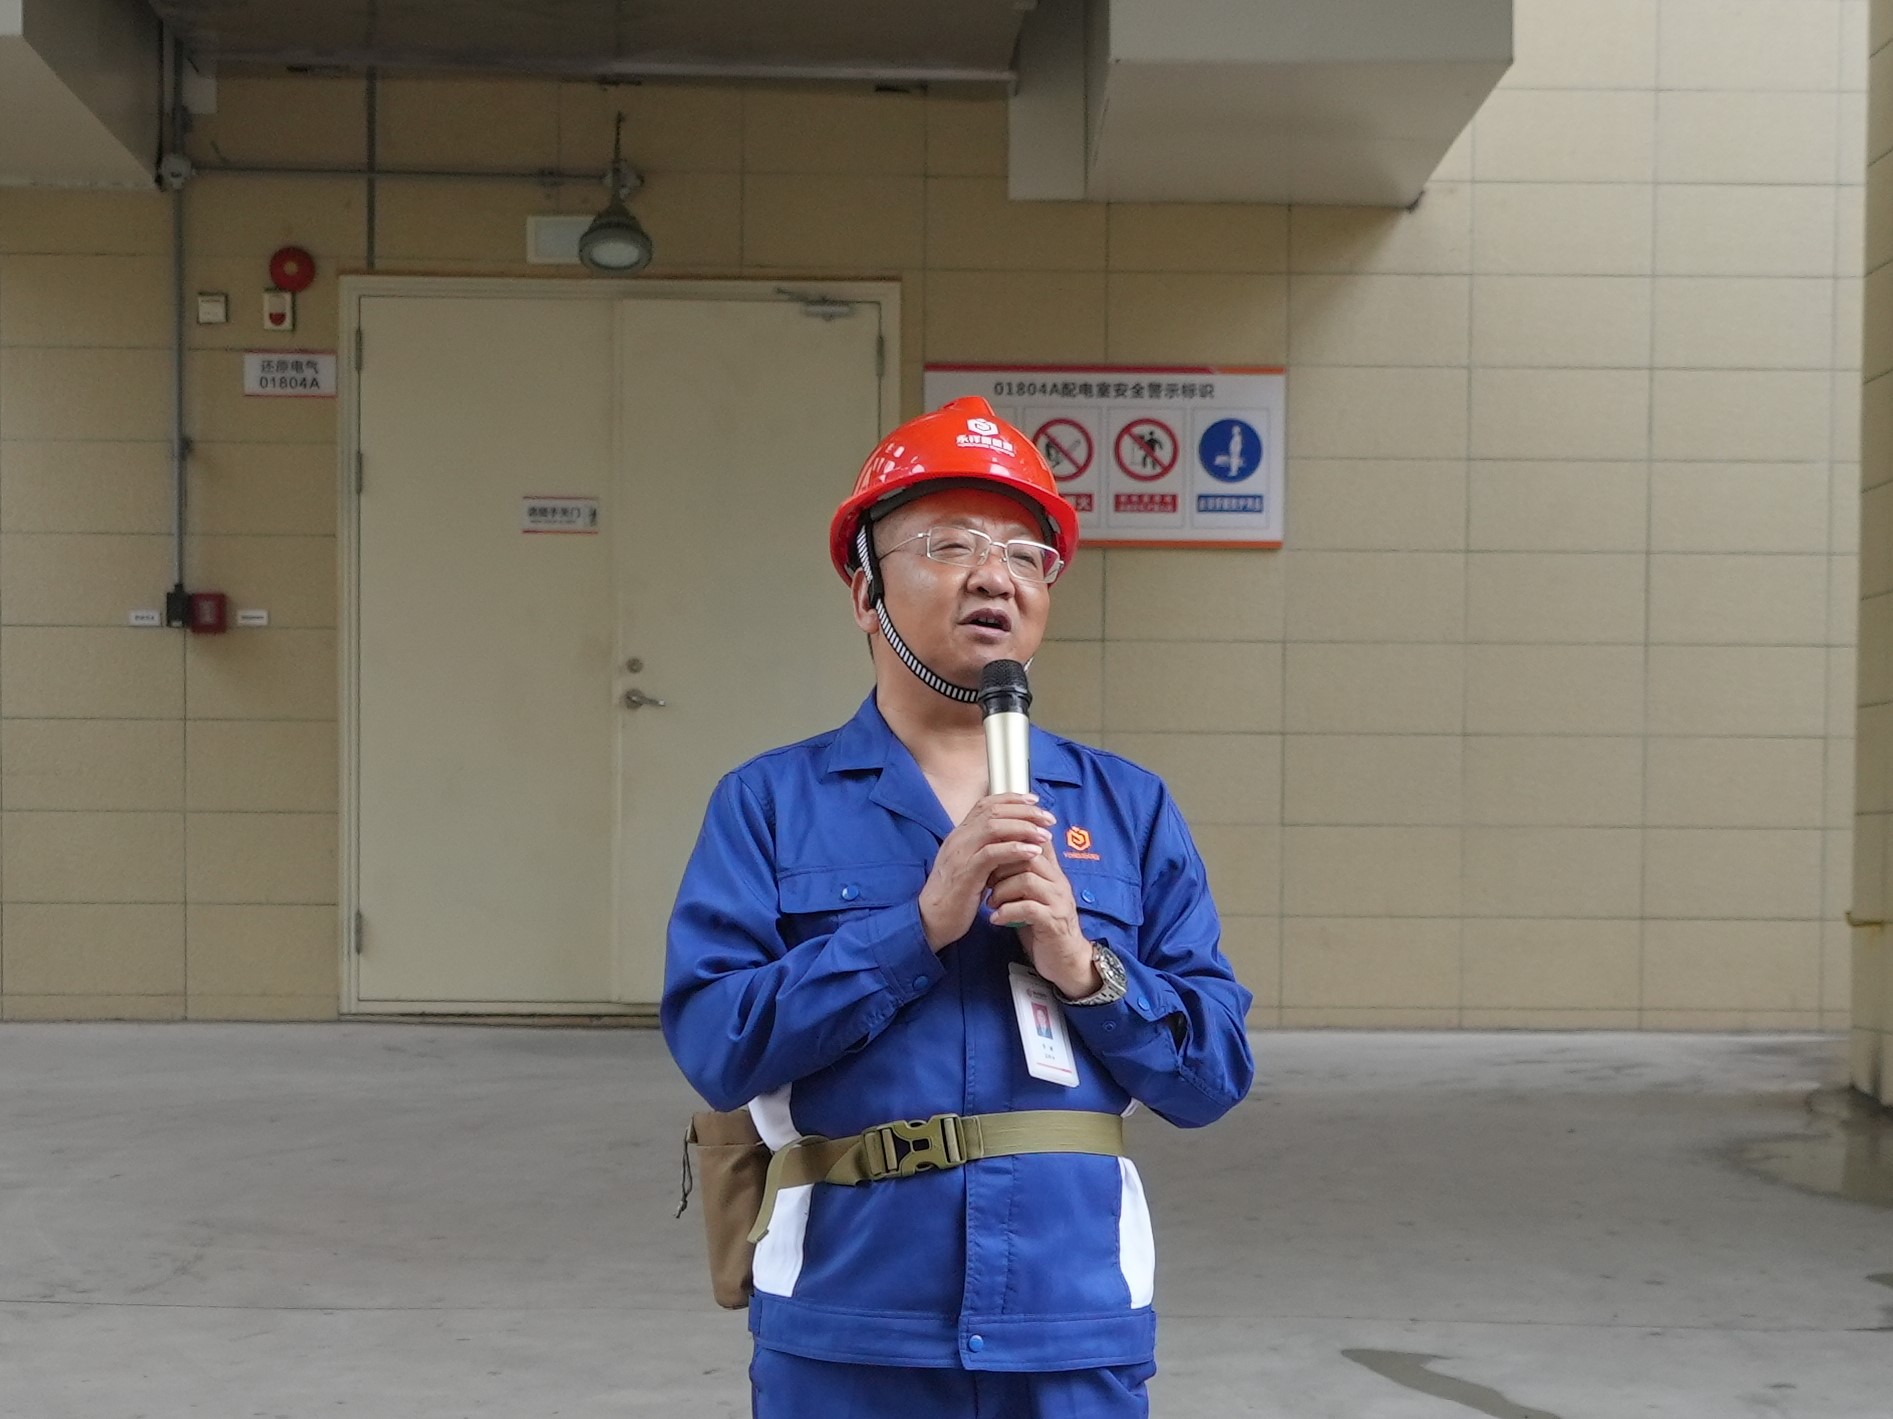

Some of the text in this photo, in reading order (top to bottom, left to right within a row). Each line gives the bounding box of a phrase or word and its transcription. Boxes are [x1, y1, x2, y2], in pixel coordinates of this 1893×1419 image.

[260, 359, 319, 374] 还原电气
[260, 376, 320, 389] 01804A
[993, 381, 1216, 399] 01804A配电室安全警示标识
